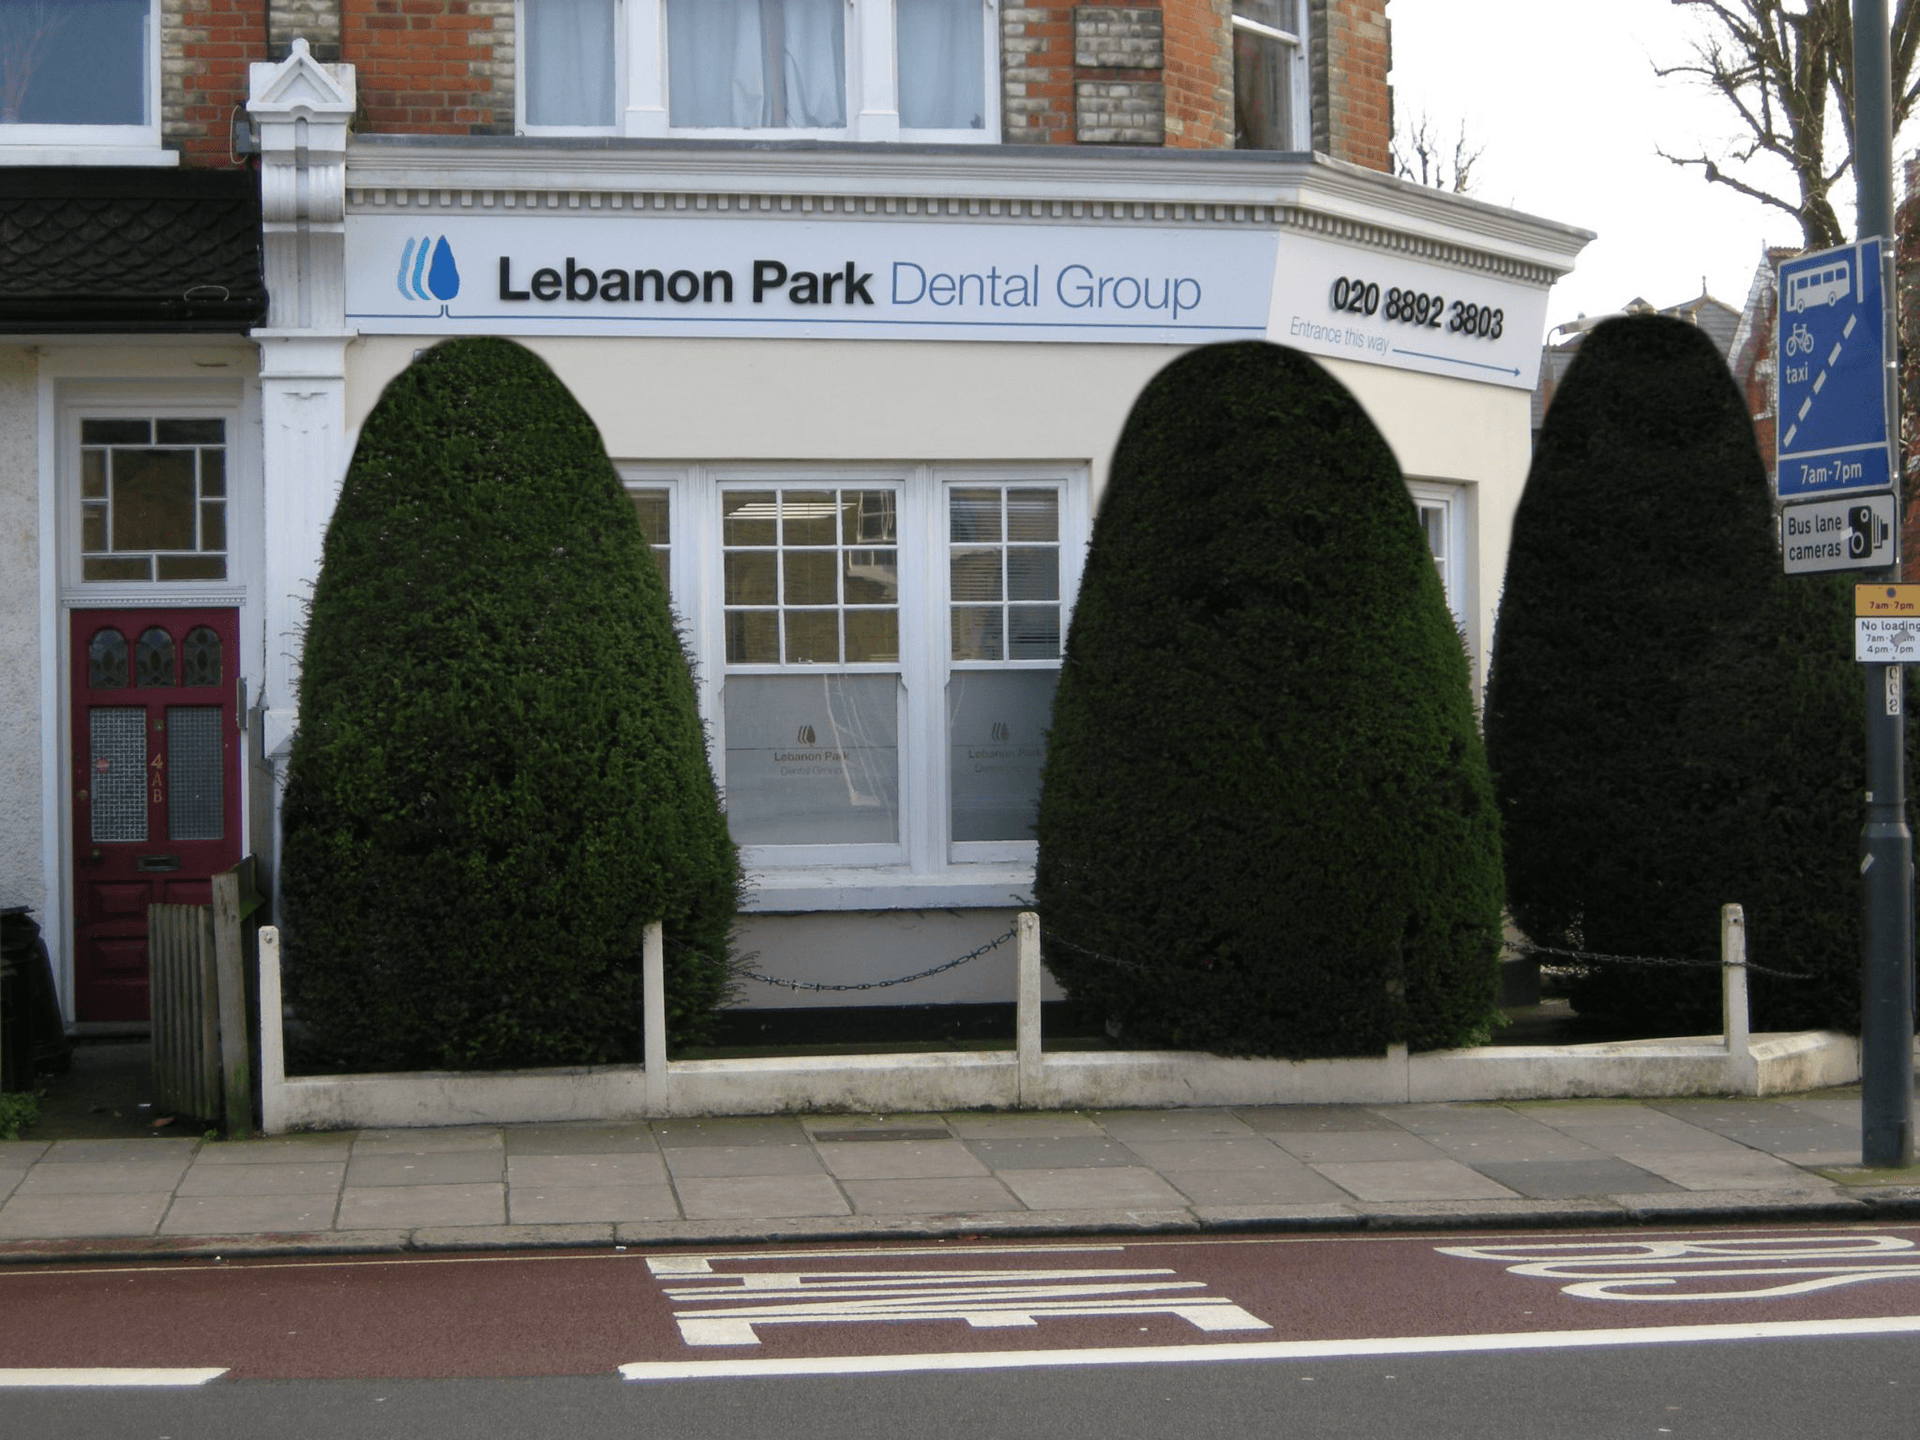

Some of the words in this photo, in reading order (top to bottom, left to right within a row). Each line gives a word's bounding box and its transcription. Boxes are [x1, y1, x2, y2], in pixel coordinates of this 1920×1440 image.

[499, 255, 733, 302] Lebanon
[752, 259, 874, 305] Park
[891, 261, 1039, 307] Dental
[1056, 264, 1201, 320] Group
[1333, 276, 1380, 316] 020
[1385, 286, 1445, 328] 8892
[1449, 300, 1504, 340] 3803
[1290, 316, 1341, 344] Entrance
[1344, 328, 1365, 349] this
[1367, 336, 1390, 356] way
[1785, 361, 1809, 385] taxi
[1788, 516, 1812, 536] Bus
[1815, 514, 1842, 533] lane
[1789, 541, 1842, 562] cameras
[1861, 620, 1878, 631] No
[774, 751, 822, 762] Lebanon
[824, 751, 850, 762] Pak
